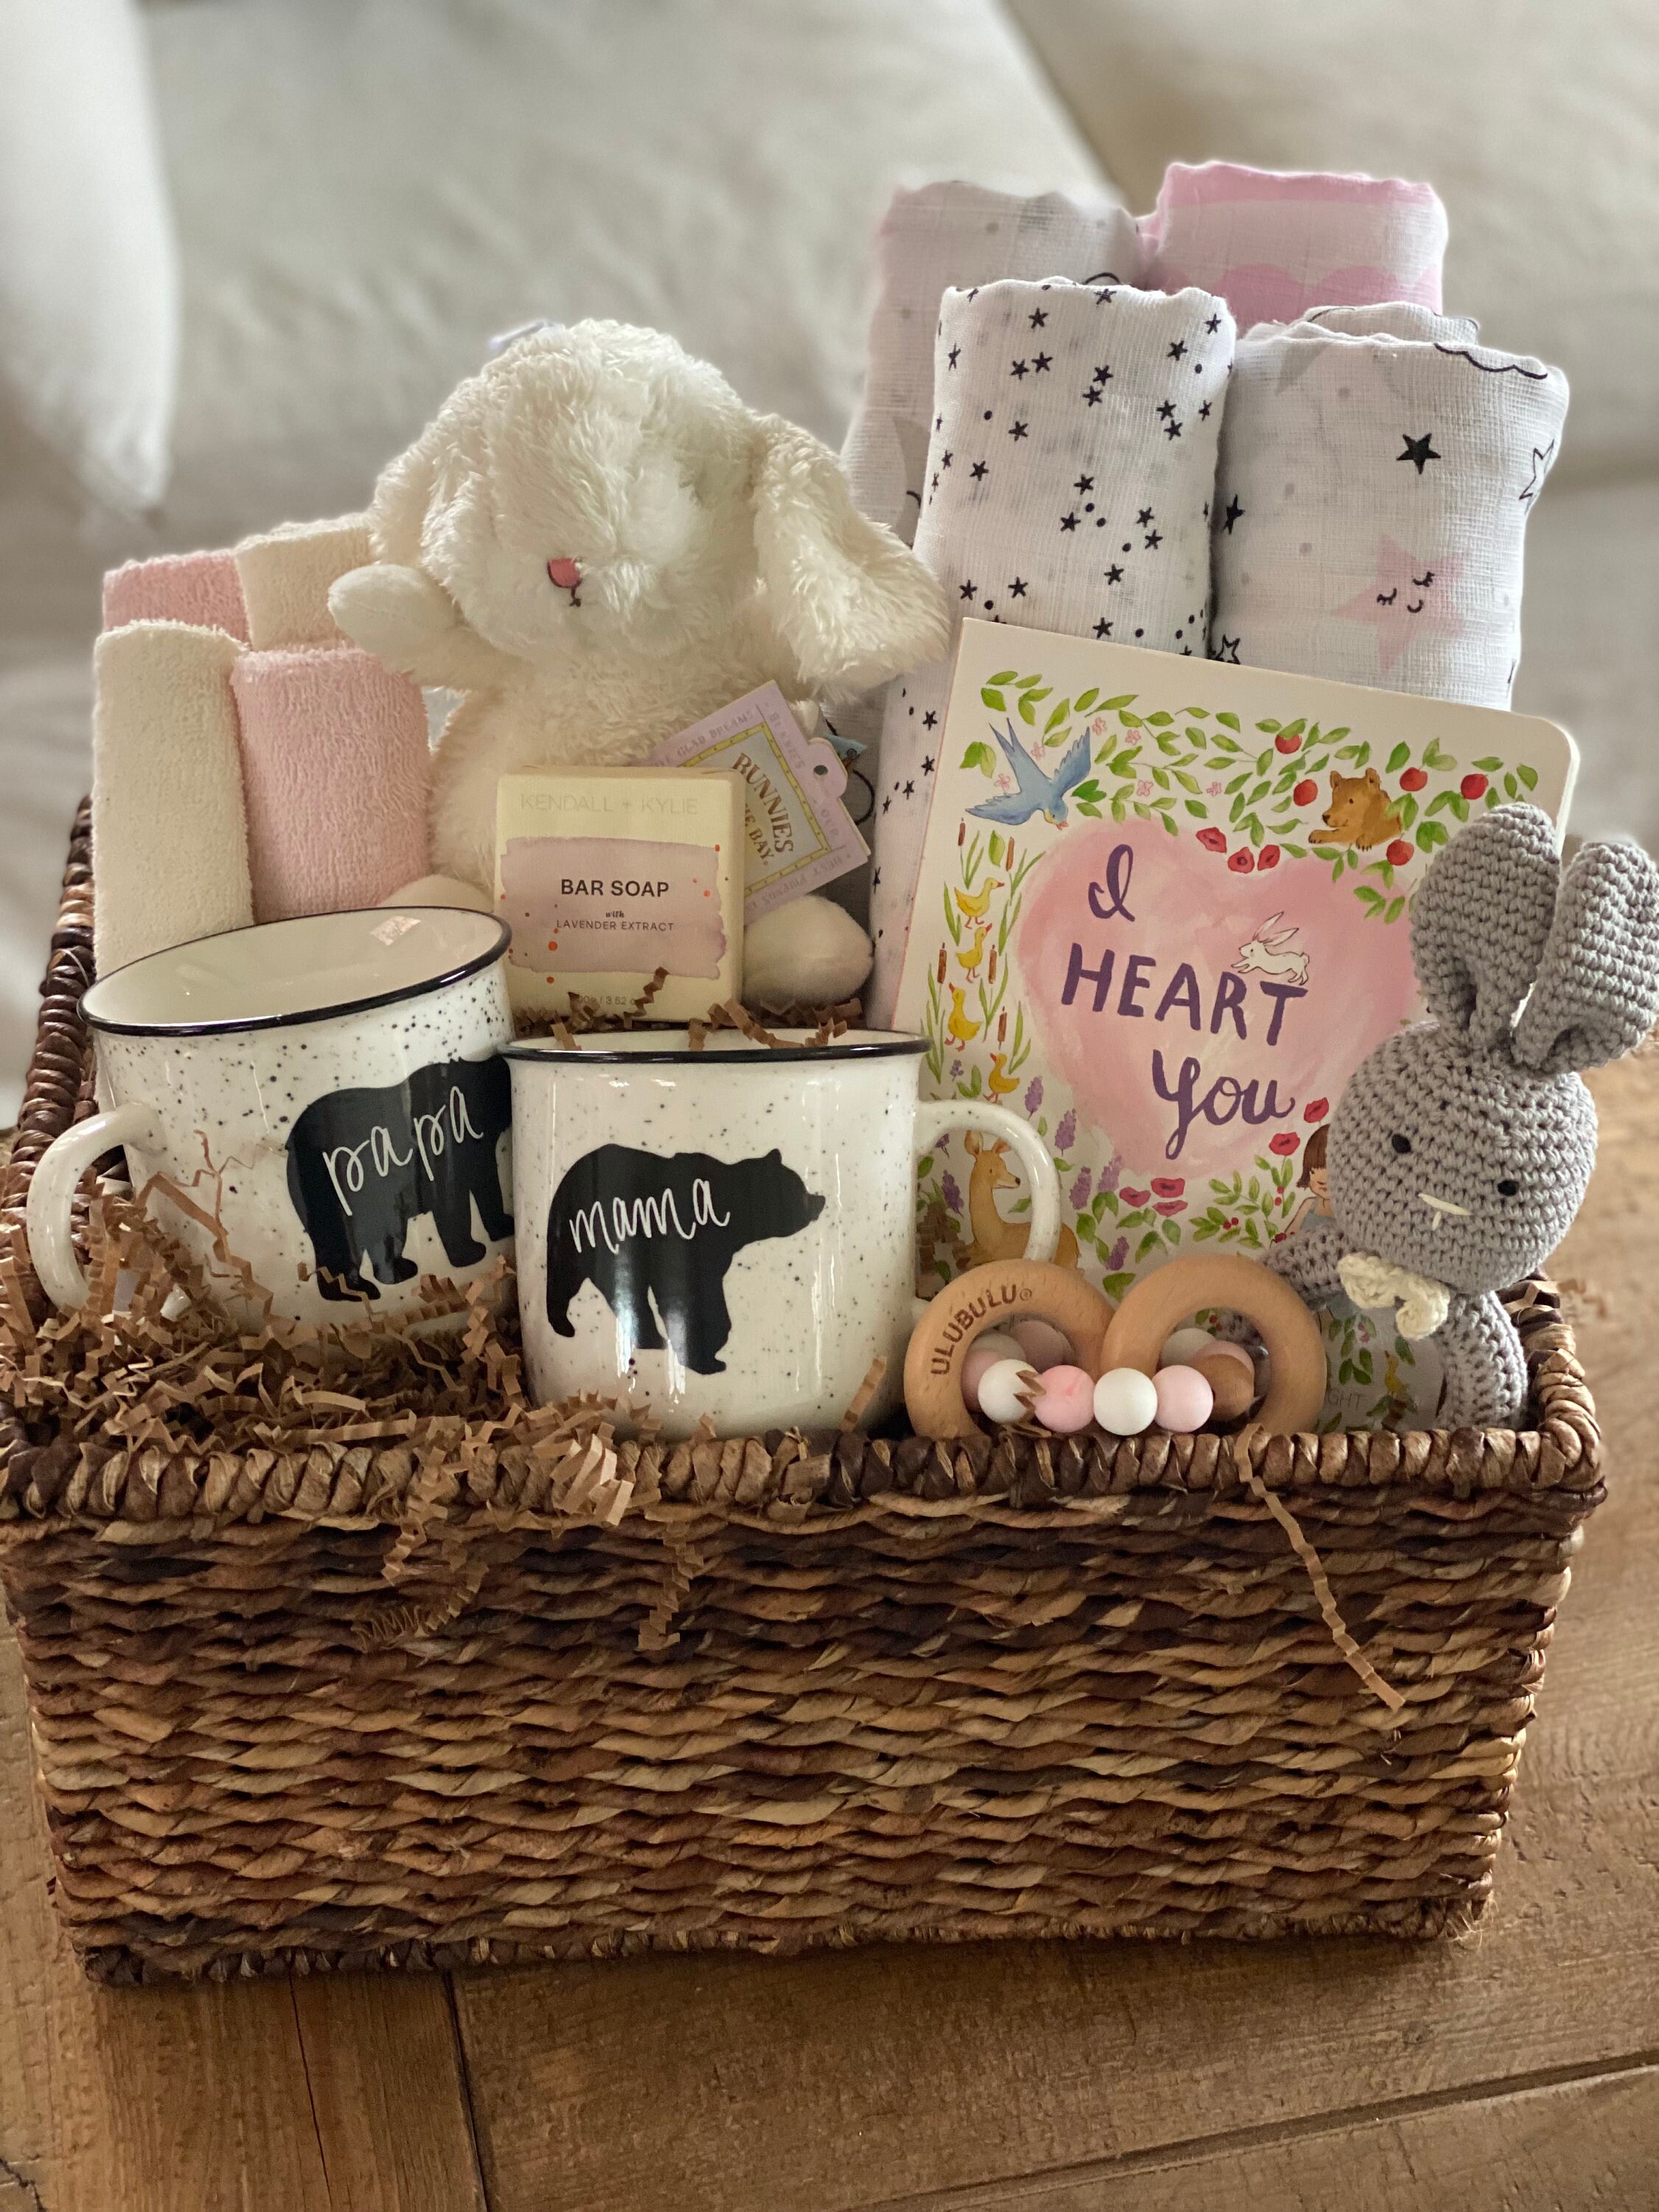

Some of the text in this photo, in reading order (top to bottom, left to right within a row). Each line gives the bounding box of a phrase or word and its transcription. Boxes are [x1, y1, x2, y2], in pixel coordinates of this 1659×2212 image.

[520, 793, 614, 813] KENDALL
[641, 797, 698, 815] KYLIE
[730, 752, 794, 853] BUNNIES
[561, 878, 669, 897] BAR SOAP
[605, 910, 625, 919] with
[1088, 844, 1135, 922] I
[557, 919, 674, 932] LAVENDER EXTRACT
[1060, 942, 1309, 1046] HEART
[321, 1085, 484, 1216] papa
[568, 1178, 730, 1253] mama
